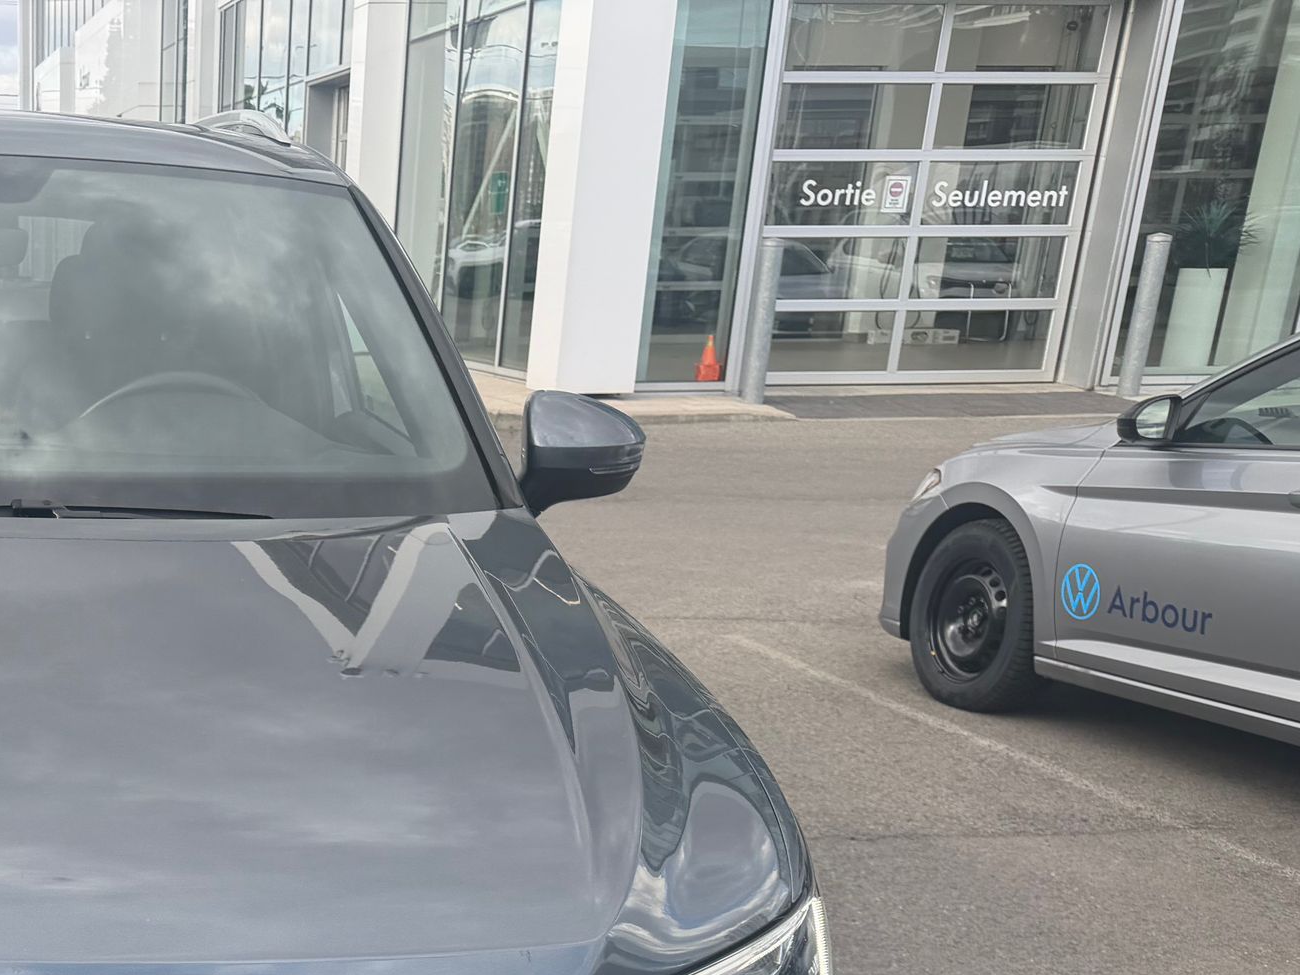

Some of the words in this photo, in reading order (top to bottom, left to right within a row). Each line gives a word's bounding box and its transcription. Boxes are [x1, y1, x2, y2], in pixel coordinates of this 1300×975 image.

[800, 179, 876, 206] Sortie
[931, 180, 1069, 207] Seulement
[1107, 585, 1213, 635] Arbour
